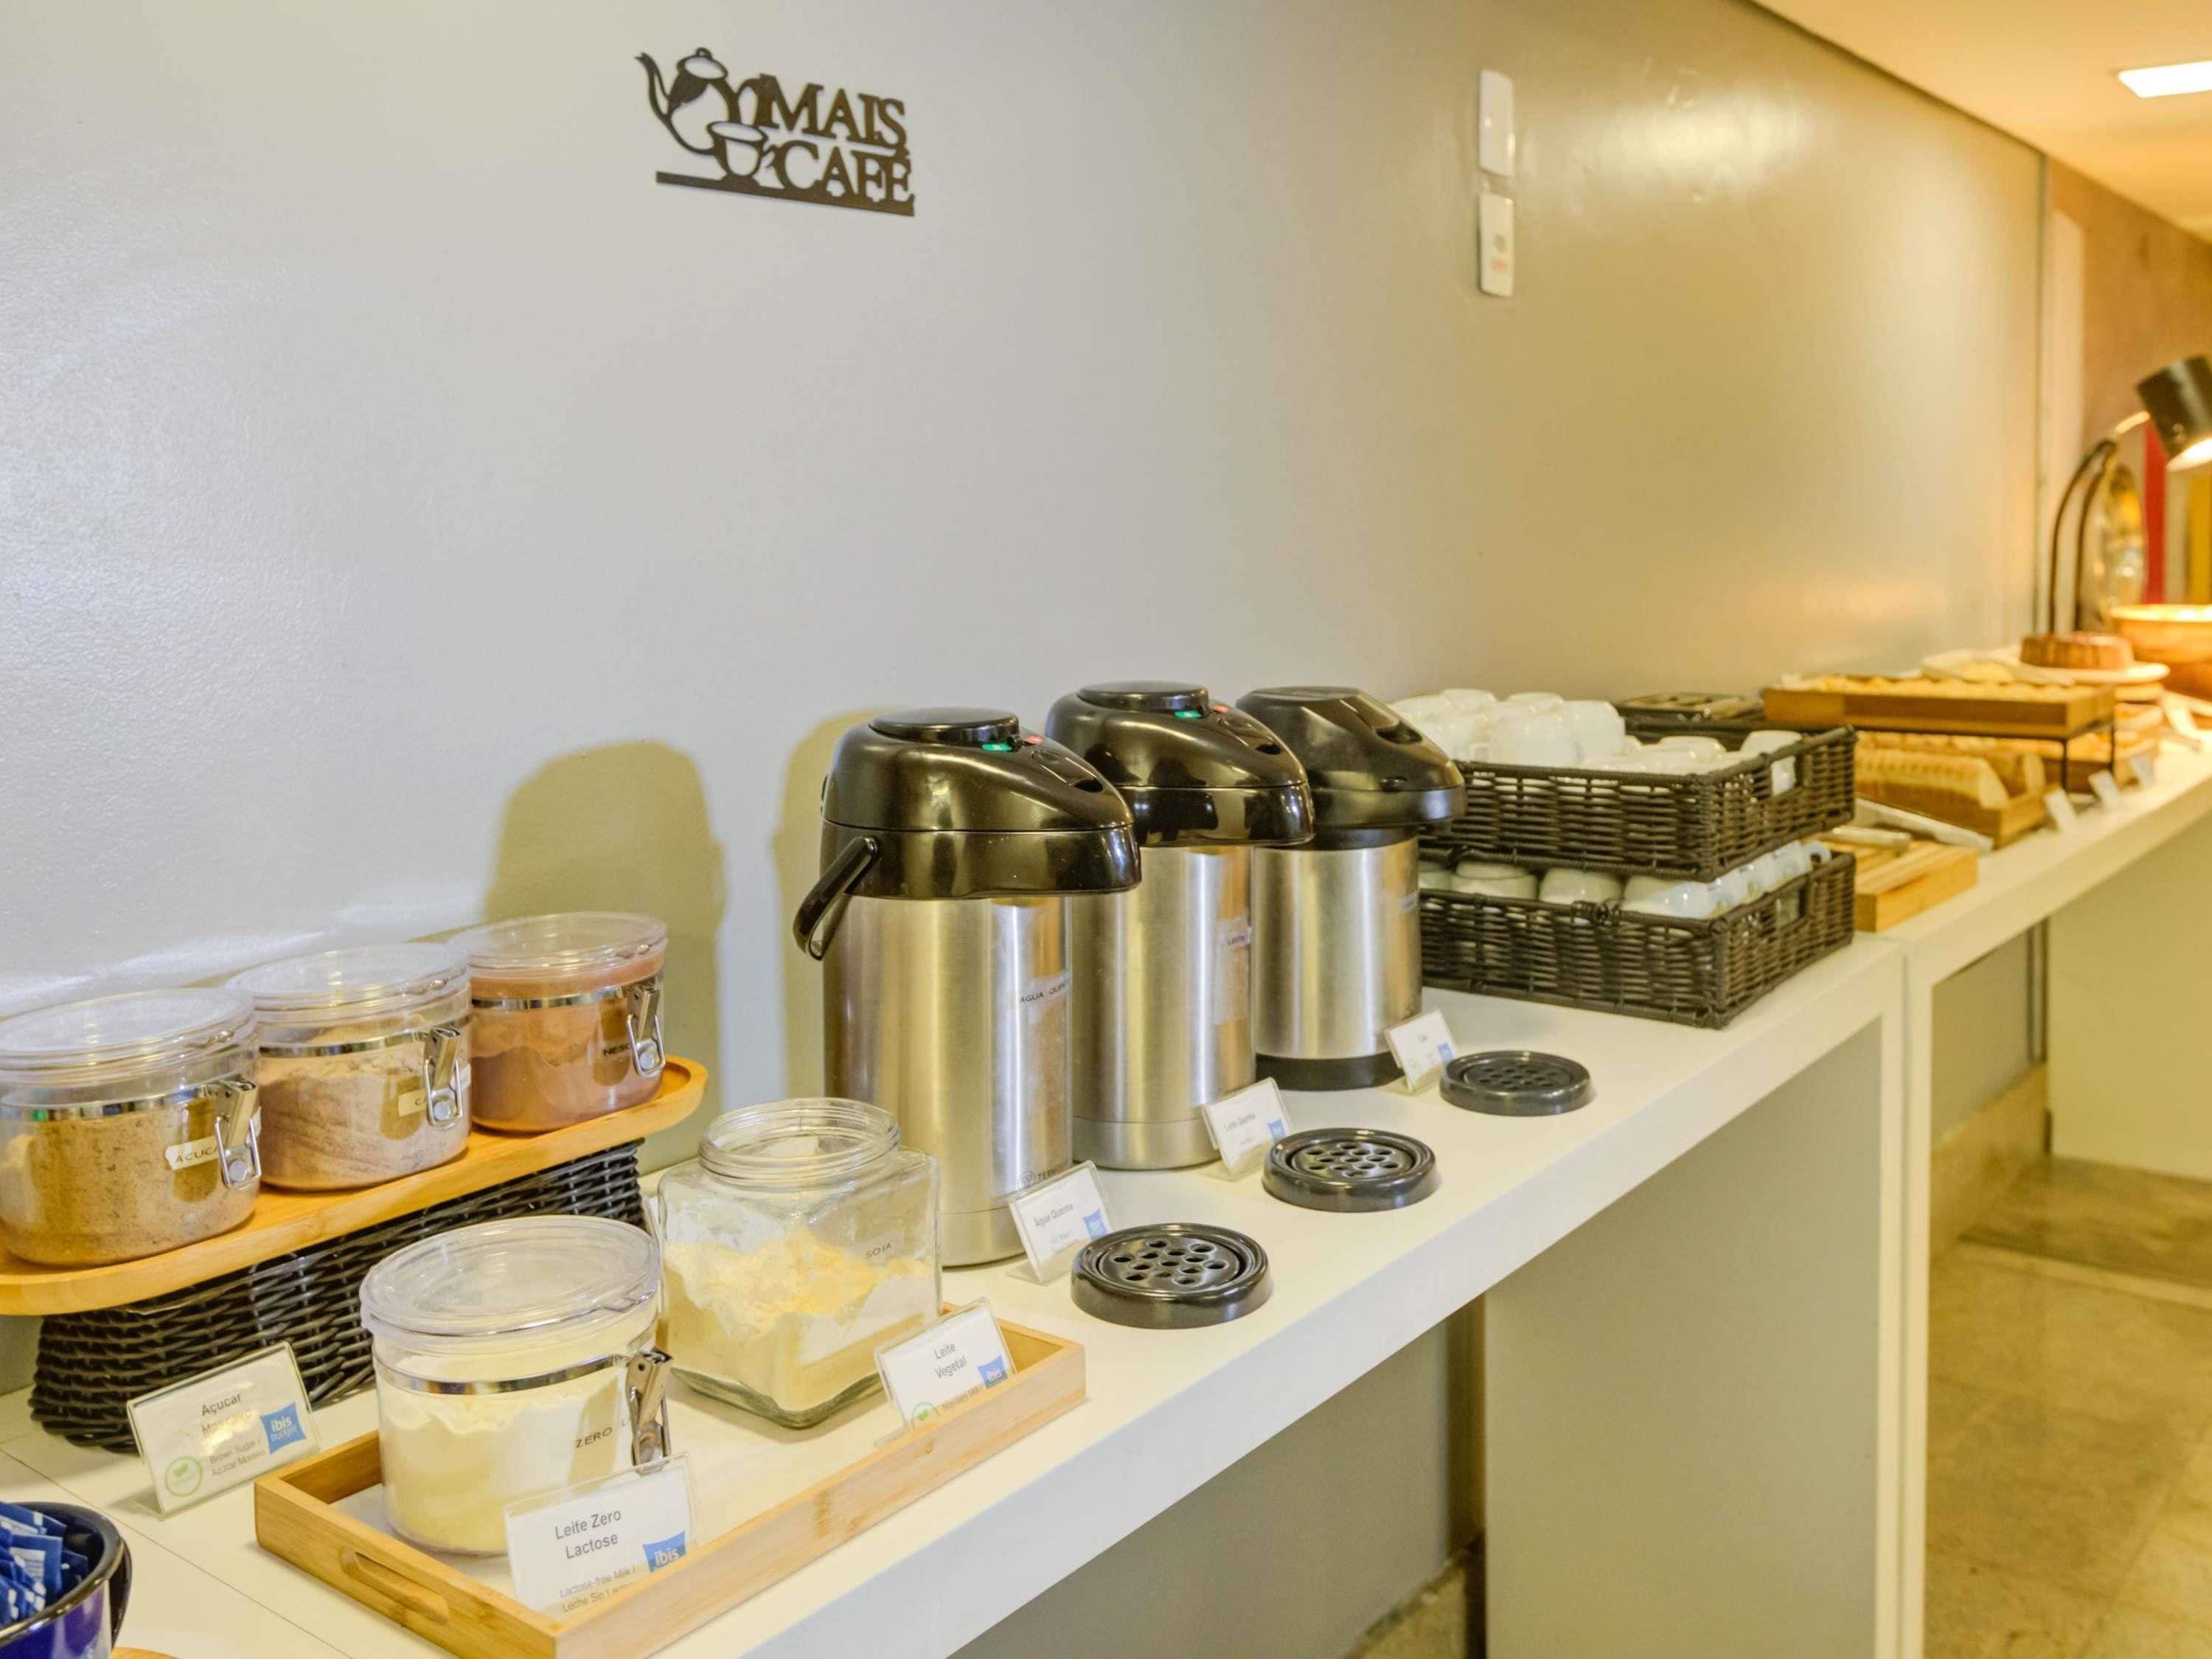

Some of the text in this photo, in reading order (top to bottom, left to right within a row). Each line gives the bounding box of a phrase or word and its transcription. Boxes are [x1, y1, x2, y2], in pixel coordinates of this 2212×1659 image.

[753, 73, 907, 151] MAIS
[933, 1343, 956, 1360] Leite
[933, 1354, 967, 1378] Vegetal
[201, 1393, 242, 1416] Açucar
[270, 1415, 292, 1433] ibis
[574, 1426, 613, 1448] ZERO
[554, 1509, 622, 1540] Leite Zero
[565, 1533, 619, 1559] Lactose
[653, 1547, 681, 1567] ibis
[561, 1596, 589, 1613] Leche
